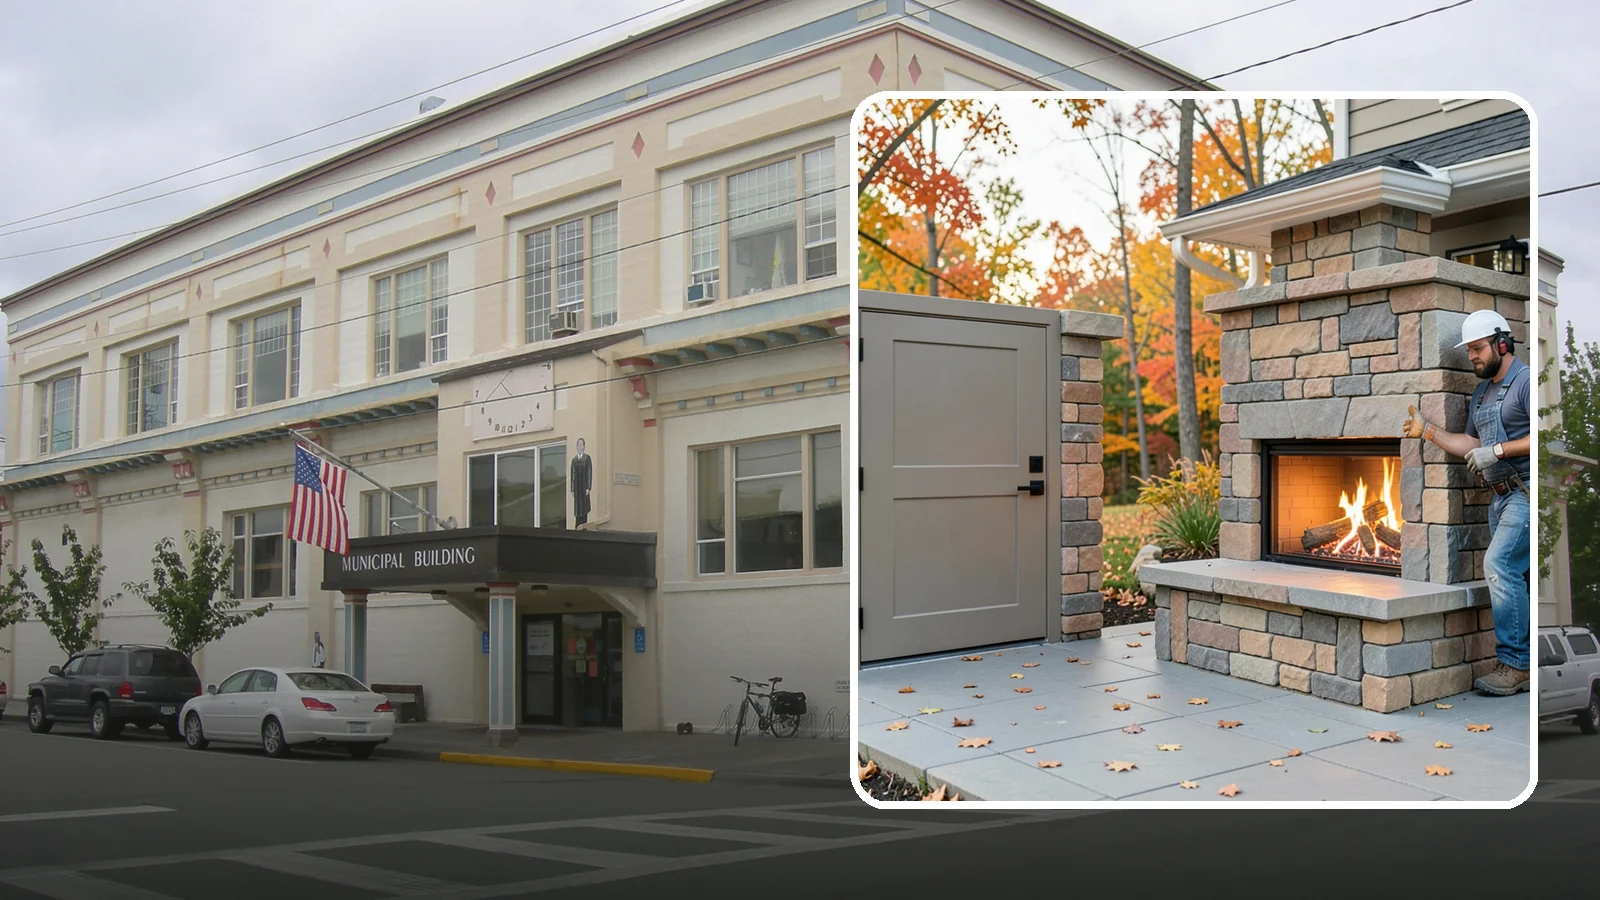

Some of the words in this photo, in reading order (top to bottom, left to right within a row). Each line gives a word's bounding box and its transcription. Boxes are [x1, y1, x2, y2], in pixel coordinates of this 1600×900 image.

[475, 390, 479, 398] 7
[536, 402, 540, 410] 4
[481, 406, 485, 415] 8
[487, 417, 492, 426] 9
[529, 413, 533, 422] 3
[494, 424, 500, 432] 10
[521, 420, 526, 428] 2
[501, 425, 506, 433] 11
[507, 425, 513, 433] 12
[342, 552, 405, 572] MUNICIPAL
[414, 546, 475, 567] BUILDING
